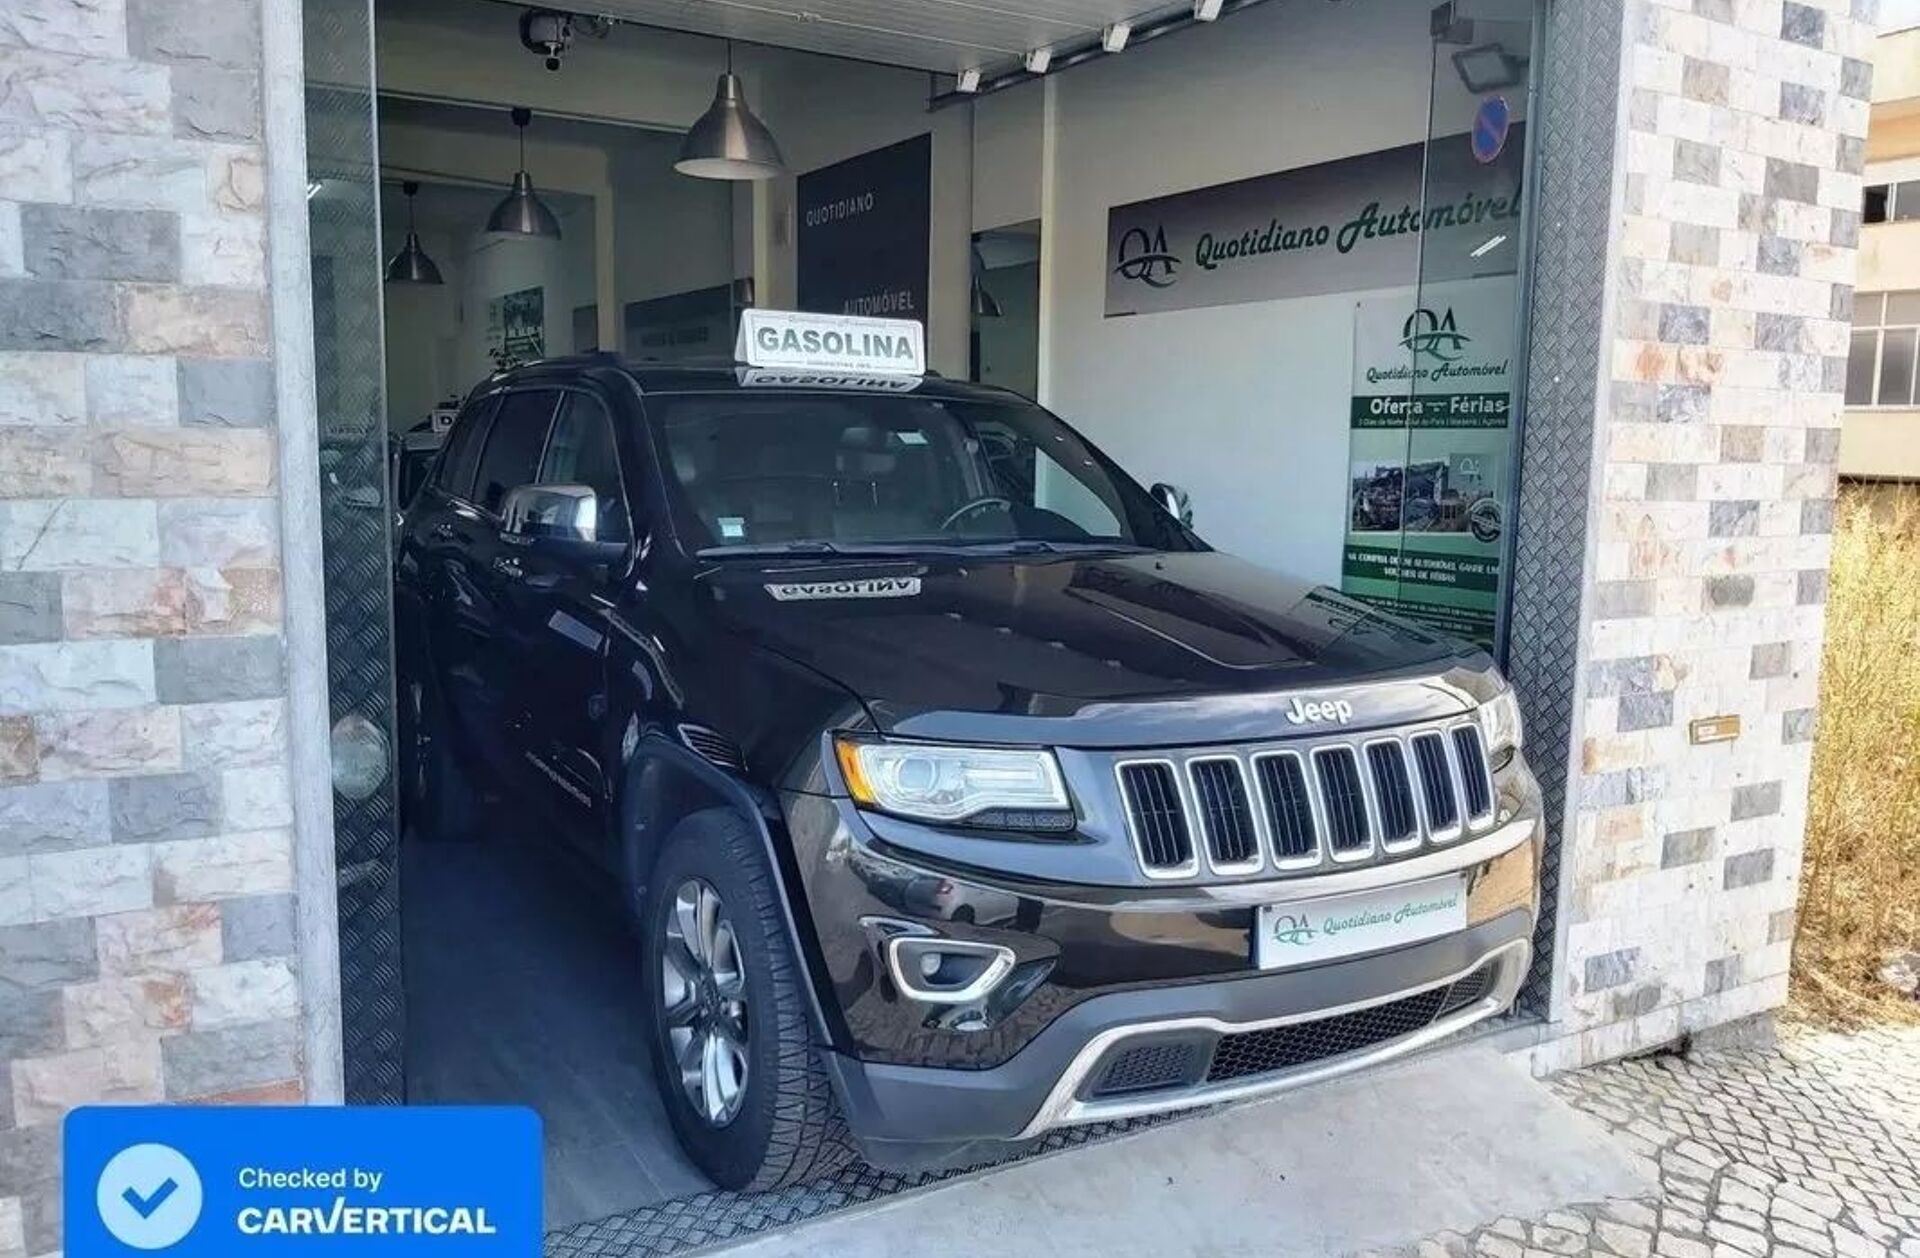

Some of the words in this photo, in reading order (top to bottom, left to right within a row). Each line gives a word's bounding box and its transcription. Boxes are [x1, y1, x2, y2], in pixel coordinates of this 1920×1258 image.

[806, 193, 874, 227] QUOTIDIANO
[1195, 219, 1330, 270] Quotidiano
[1337, 187, 1522, 254] Automóvel
[757, 326, 914, 360] GASOLINA
[1431, 359, 1508, 382] Automóvel
[1450, 395, 1505, 414] Férias
[1284, 696, 1352, 725] Jeep
[1322, 911, 1392, 936] Quotidiano
[1394, 892, 1458, 924] Automóvel
